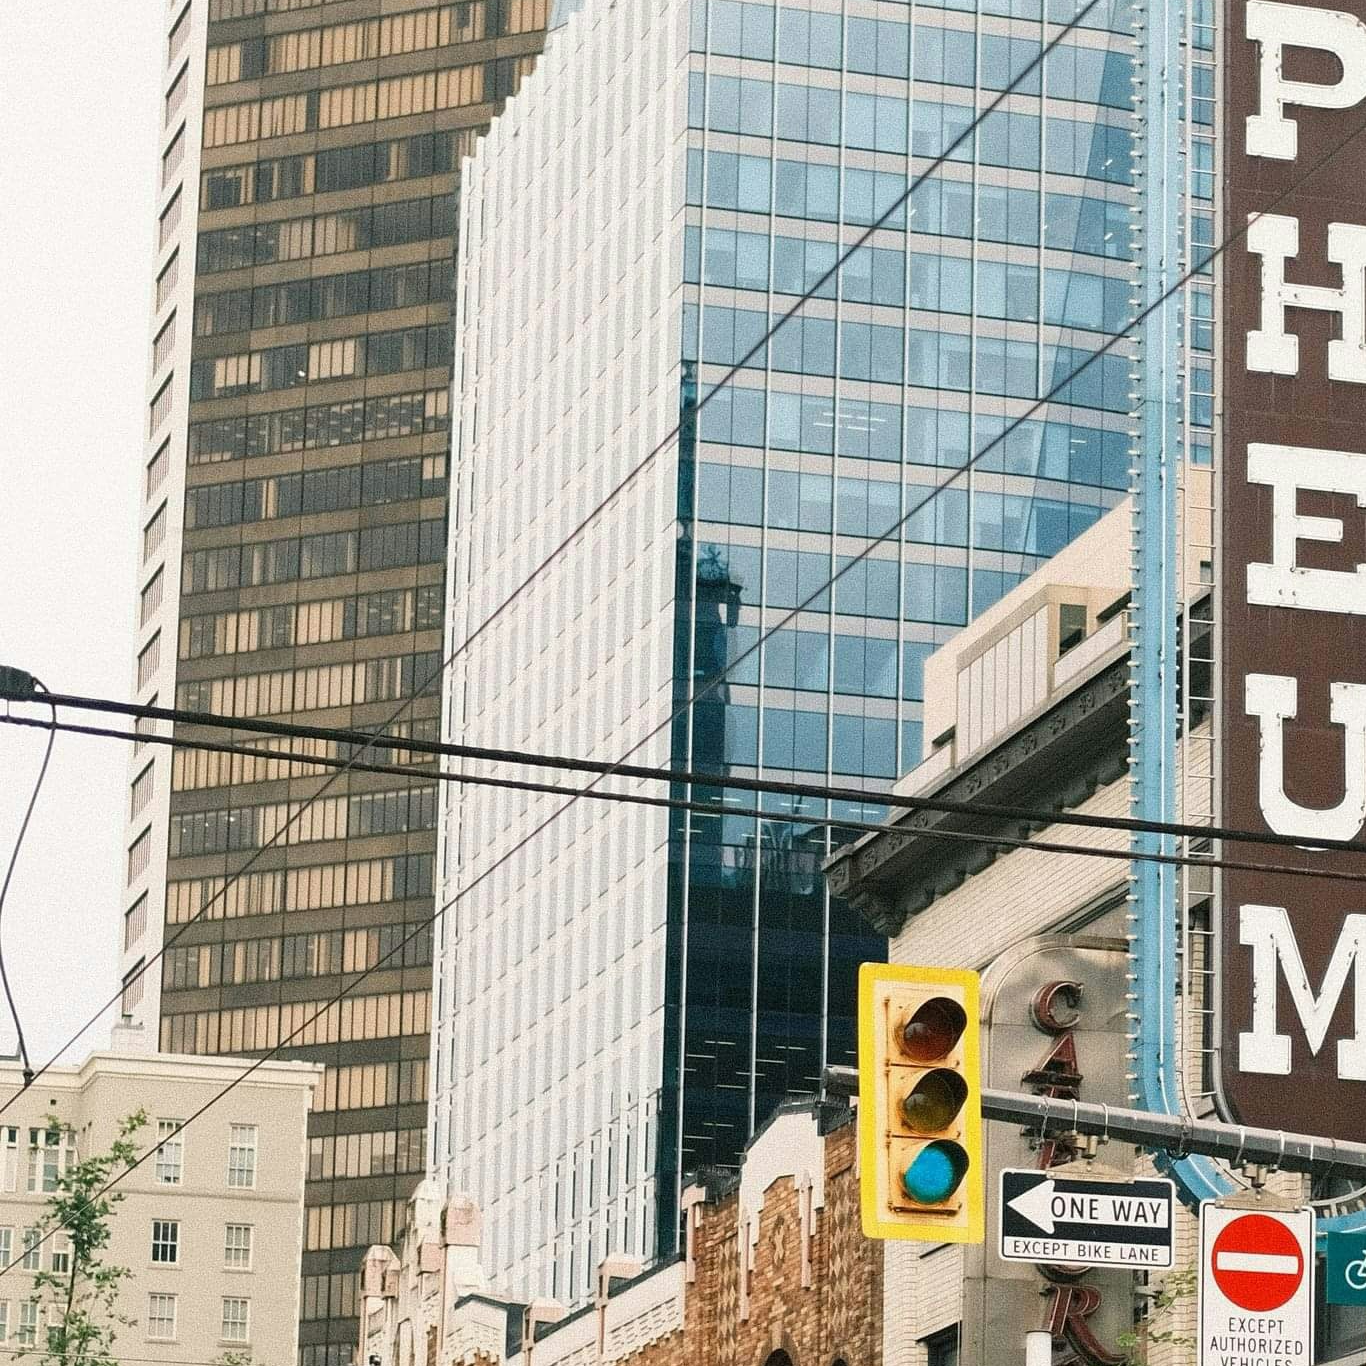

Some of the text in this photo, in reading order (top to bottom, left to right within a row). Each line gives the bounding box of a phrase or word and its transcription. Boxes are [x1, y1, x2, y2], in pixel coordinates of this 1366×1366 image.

[1050, 1195, 1162, 1224] ONE WAY
[1013, 1239, 1160, 1262] EXCEPT BIKE LANE
[1228, 1317, 1285, 1335] EXCEPT
[1209, 1335, 1304, 1357] AUTHORIZED
